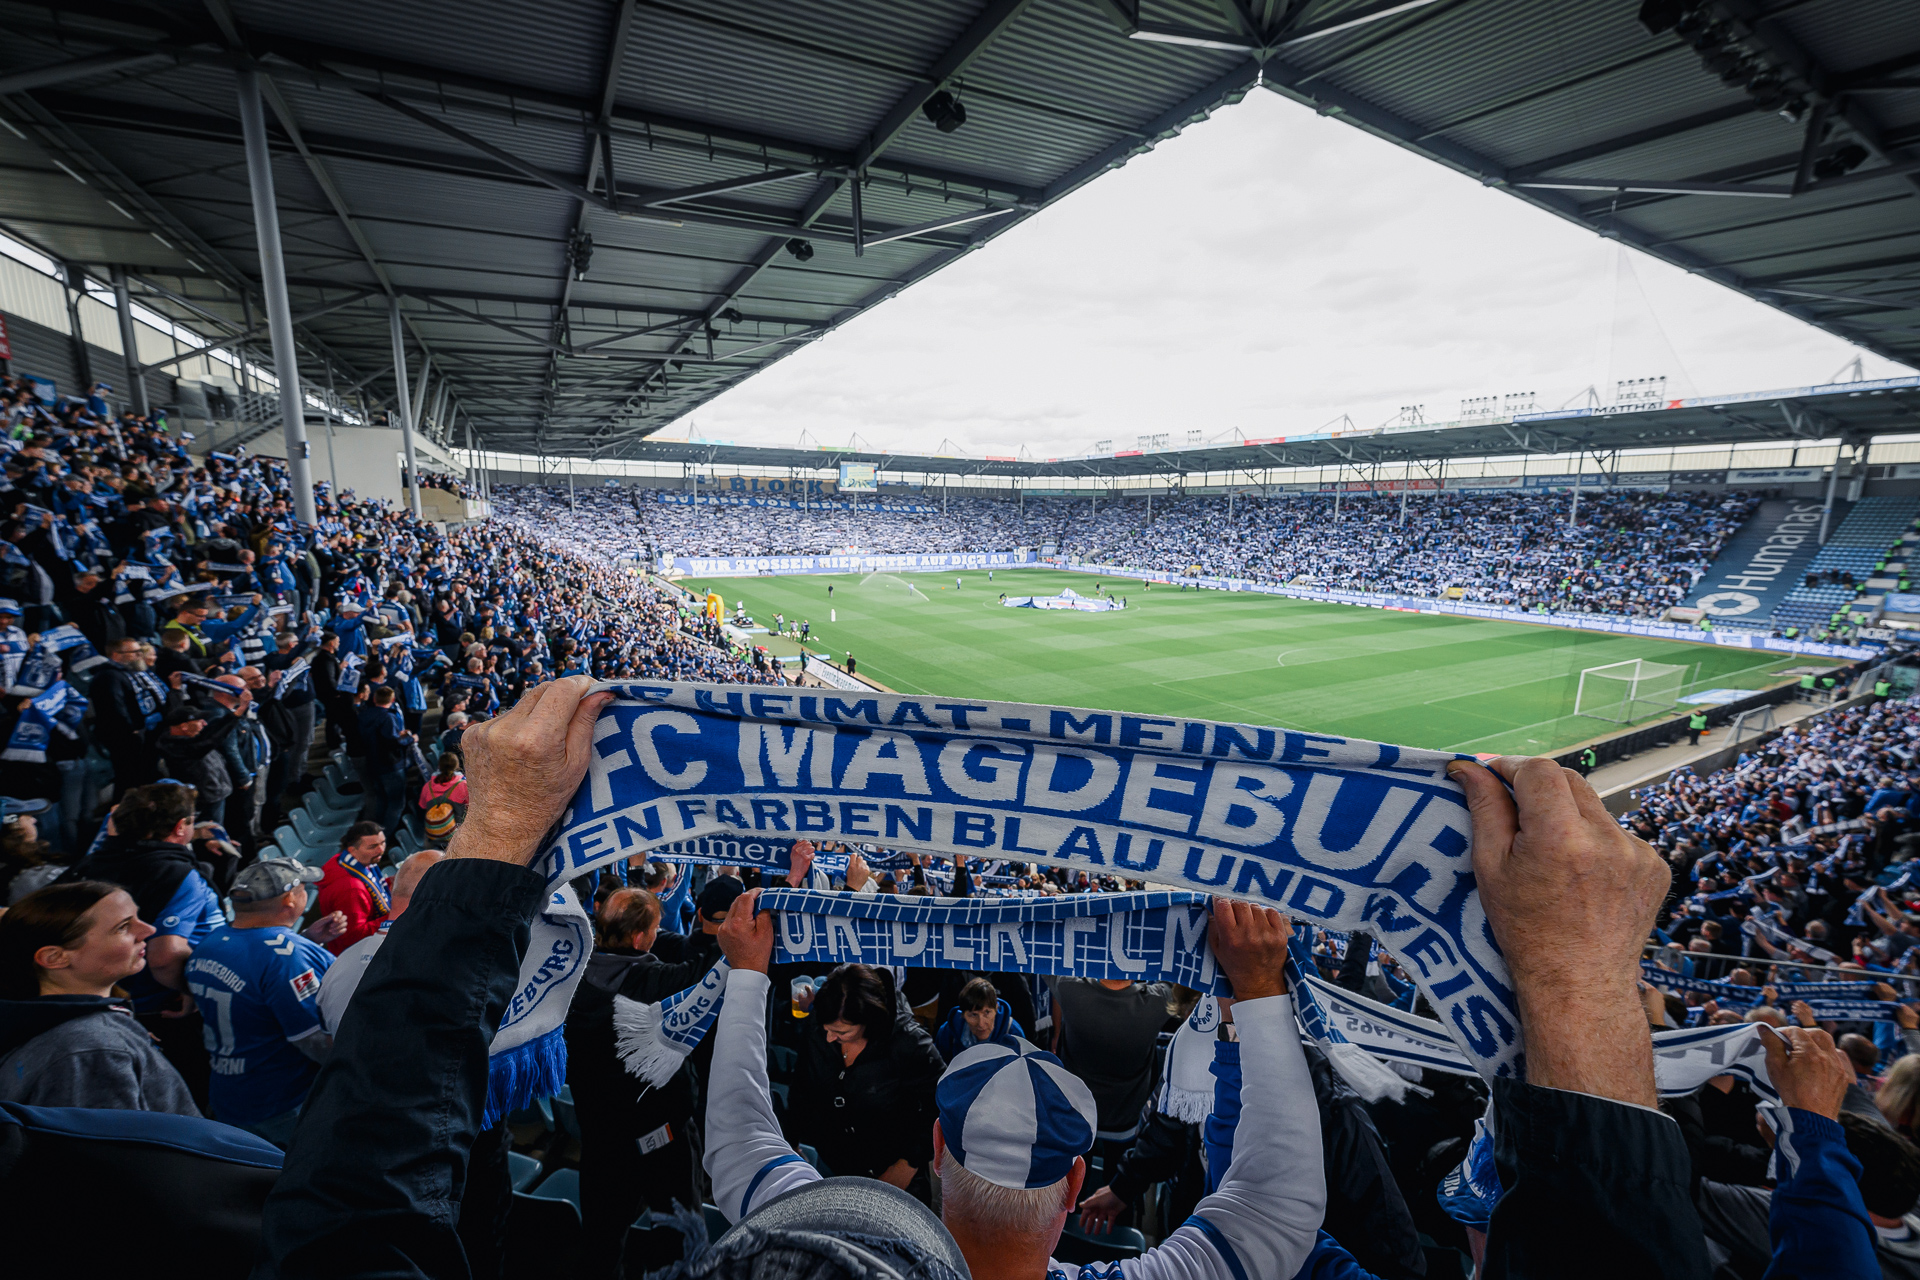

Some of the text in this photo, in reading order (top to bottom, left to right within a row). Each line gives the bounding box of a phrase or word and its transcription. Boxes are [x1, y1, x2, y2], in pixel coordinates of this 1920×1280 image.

[729, 477, 823, 494] BLOCK
[754, 499, 791, 507] VON
[689, 559, 731, 571] WIR
[735, 557, 815, 570] STOSSEN
[920, 554, 949, 566] AUF
[989, 553, 1008, 565] AN
[1717, 504, 1826, 591] Humanas
[695, 690, 987, 730] HEIMAT
[1050, 709, 1347, 762] MEINE
[588, 711, 708, 813] FC
[676, 798, 933, 843] FARBEN
[954, 809, 1166, 872] BLAU
[1184, 846, 1346, 919] UND
[781, 909, 863, 957] UR
[893, 919, 1028, 966] DER
